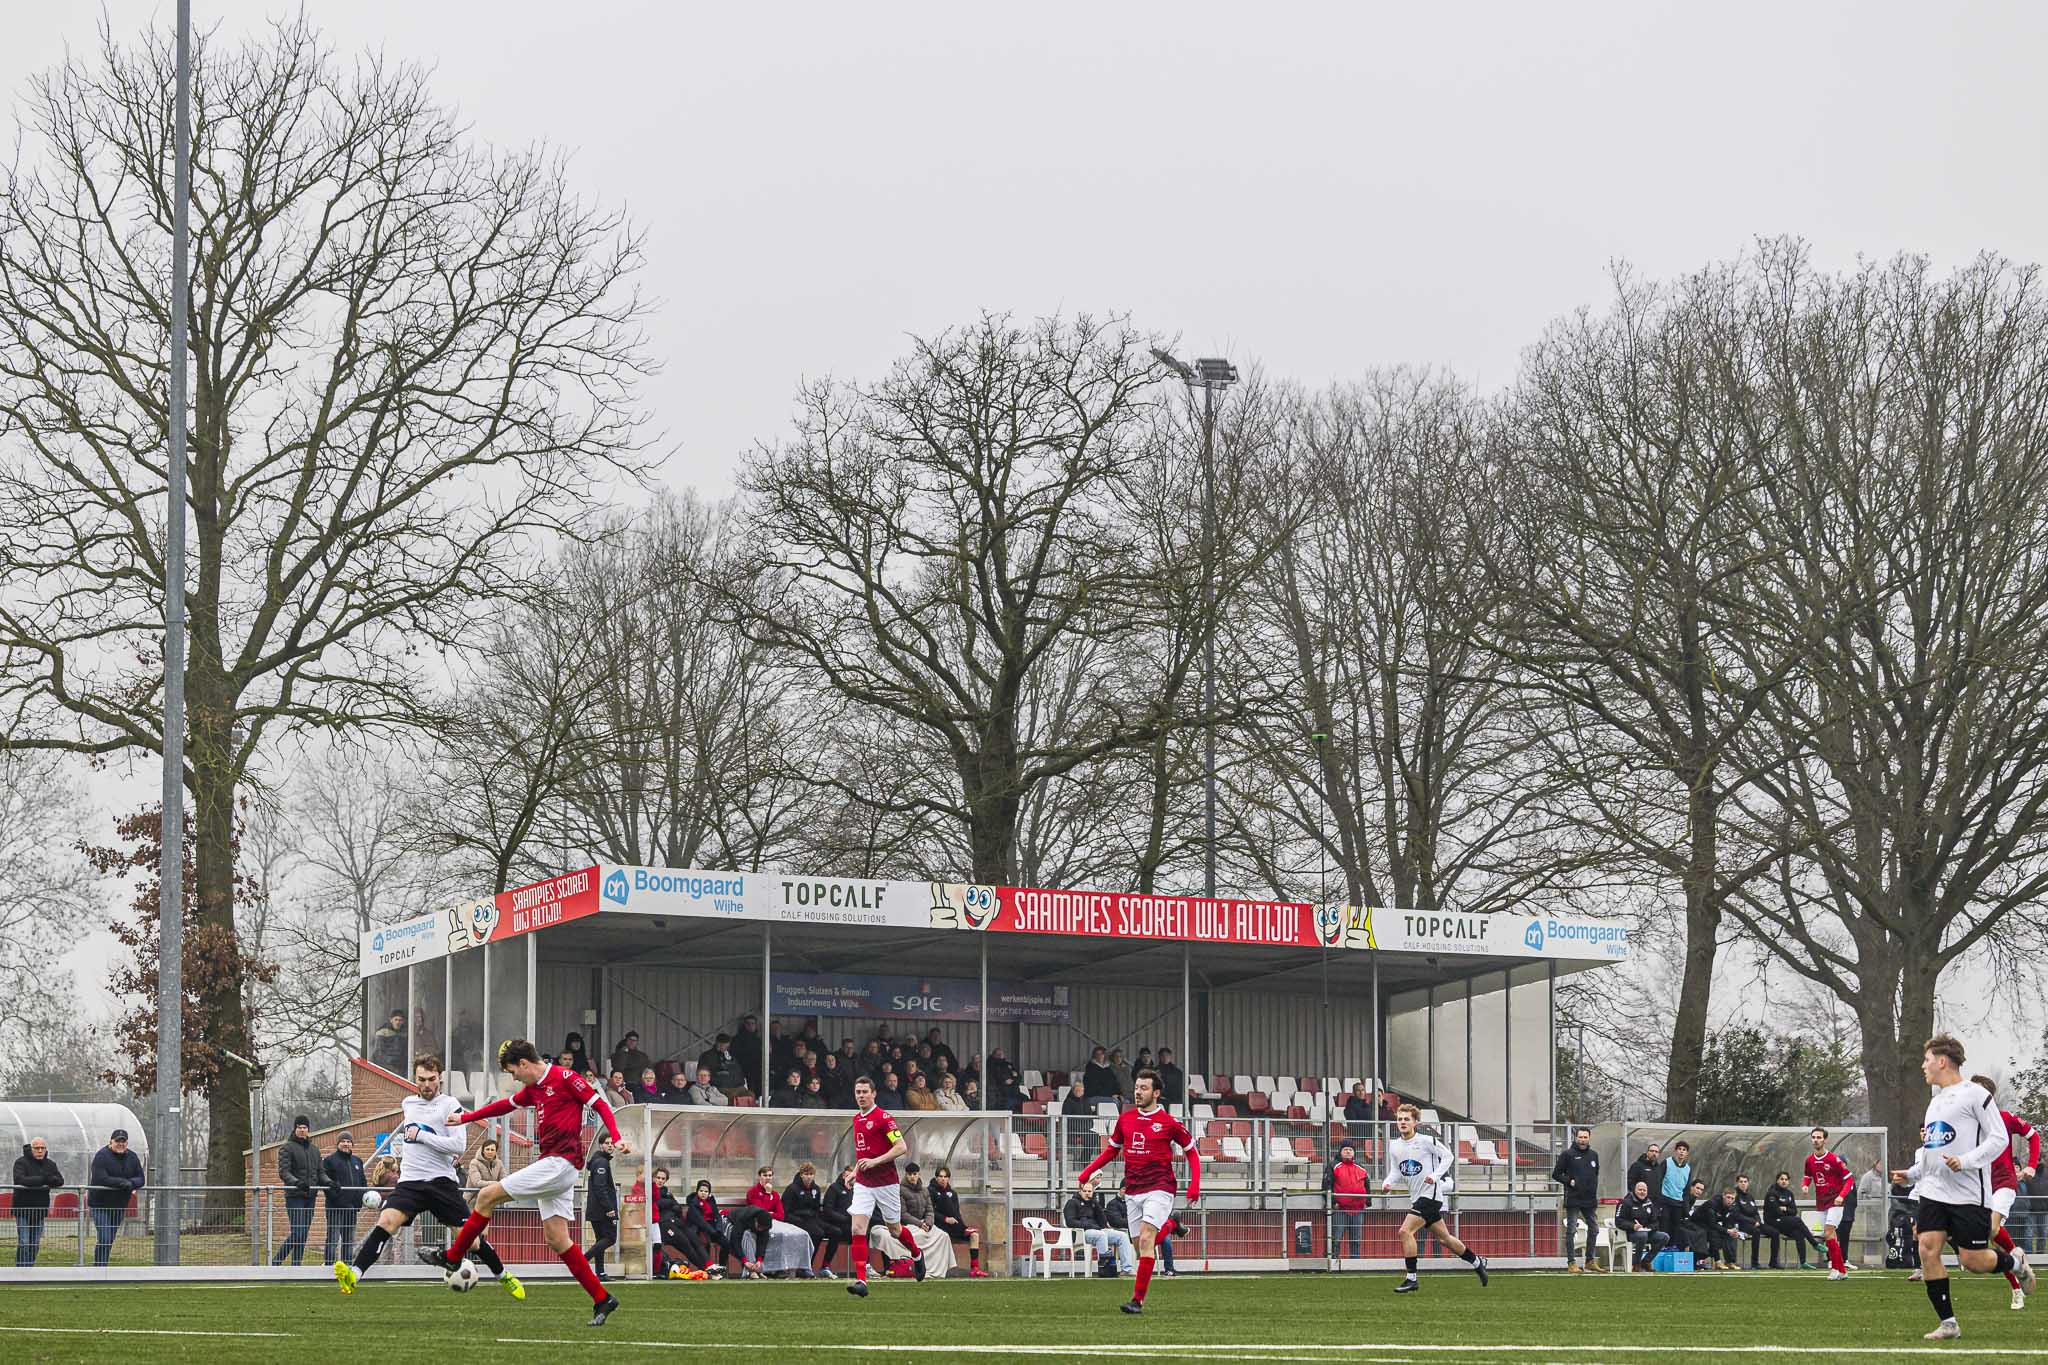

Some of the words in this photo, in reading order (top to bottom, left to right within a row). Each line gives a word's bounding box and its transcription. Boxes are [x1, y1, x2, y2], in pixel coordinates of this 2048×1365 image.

[512, 881, 555, 912] SAAMPIES
[556, 872, 589, 899] SCOREN
[635, 869, 743, 900] Boomgaard
[782, 881, 886, 909] TOPCALF
[513, 910, 529, 932] WIJ
[532, 901, 562, 928] ALTIJD!
[714, 899, 743, 914] Wijhe
[781, 910, 801, 920] CALF
[804, 911, 840, 921] HOUSING
[842, 913, 887, 923] SOLUTIONS
[1014, 891, 1111, 935] SAAMPIES
[1118, 898, 1188, 938] SCOREN
[1195, 902, 1228, 939] WIJ
[1235, 903, 1299, 943] ALTIJD!
[385, 916, 434, 941] Boomgaard
[1404, 915, 1489, 940] TOPCALF
[380, 946, 416, 965] TOPCALF
[1454, 943, 1489, 953] SOLUTIONS
[892, 995, 942, 1012] SPIE
